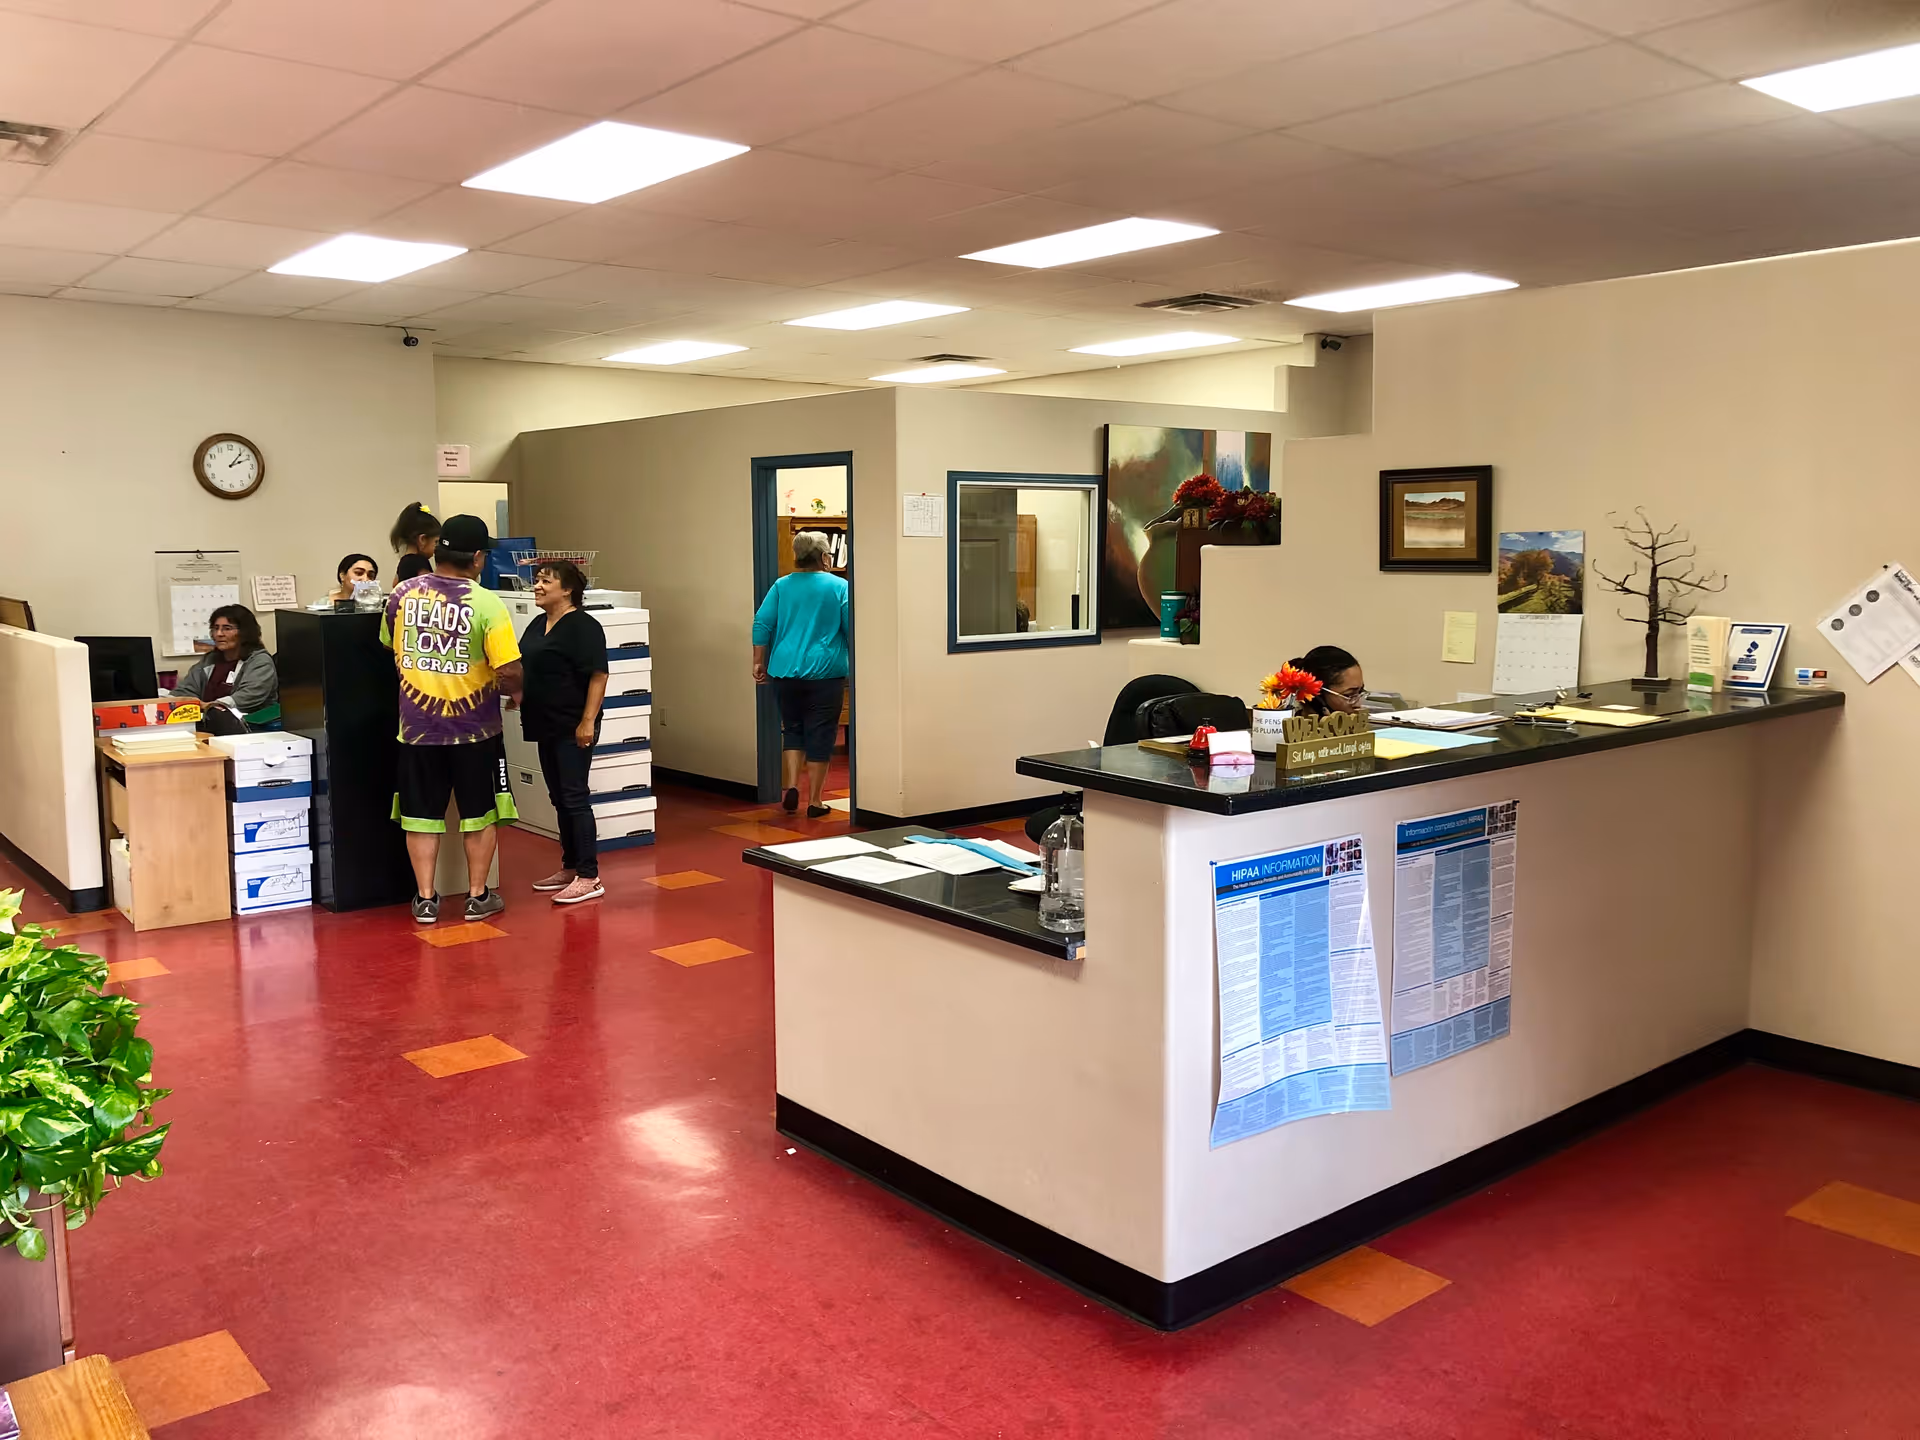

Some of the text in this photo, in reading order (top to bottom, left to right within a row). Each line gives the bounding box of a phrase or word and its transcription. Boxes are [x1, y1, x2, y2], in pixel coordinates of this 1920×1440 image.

[404, 597, 475, 636] BEADS
[402, 629, 471, 659] LOVE
[401, 655, 470, 675] & CRAB
[1264, 718, 1282, 726] PENS
[1283, 709, 1369, 743] WELCOME
[1292, 750, 1302, 762] Sit
[1231, 853, 1320, 882] HIPAA INFORMATION
